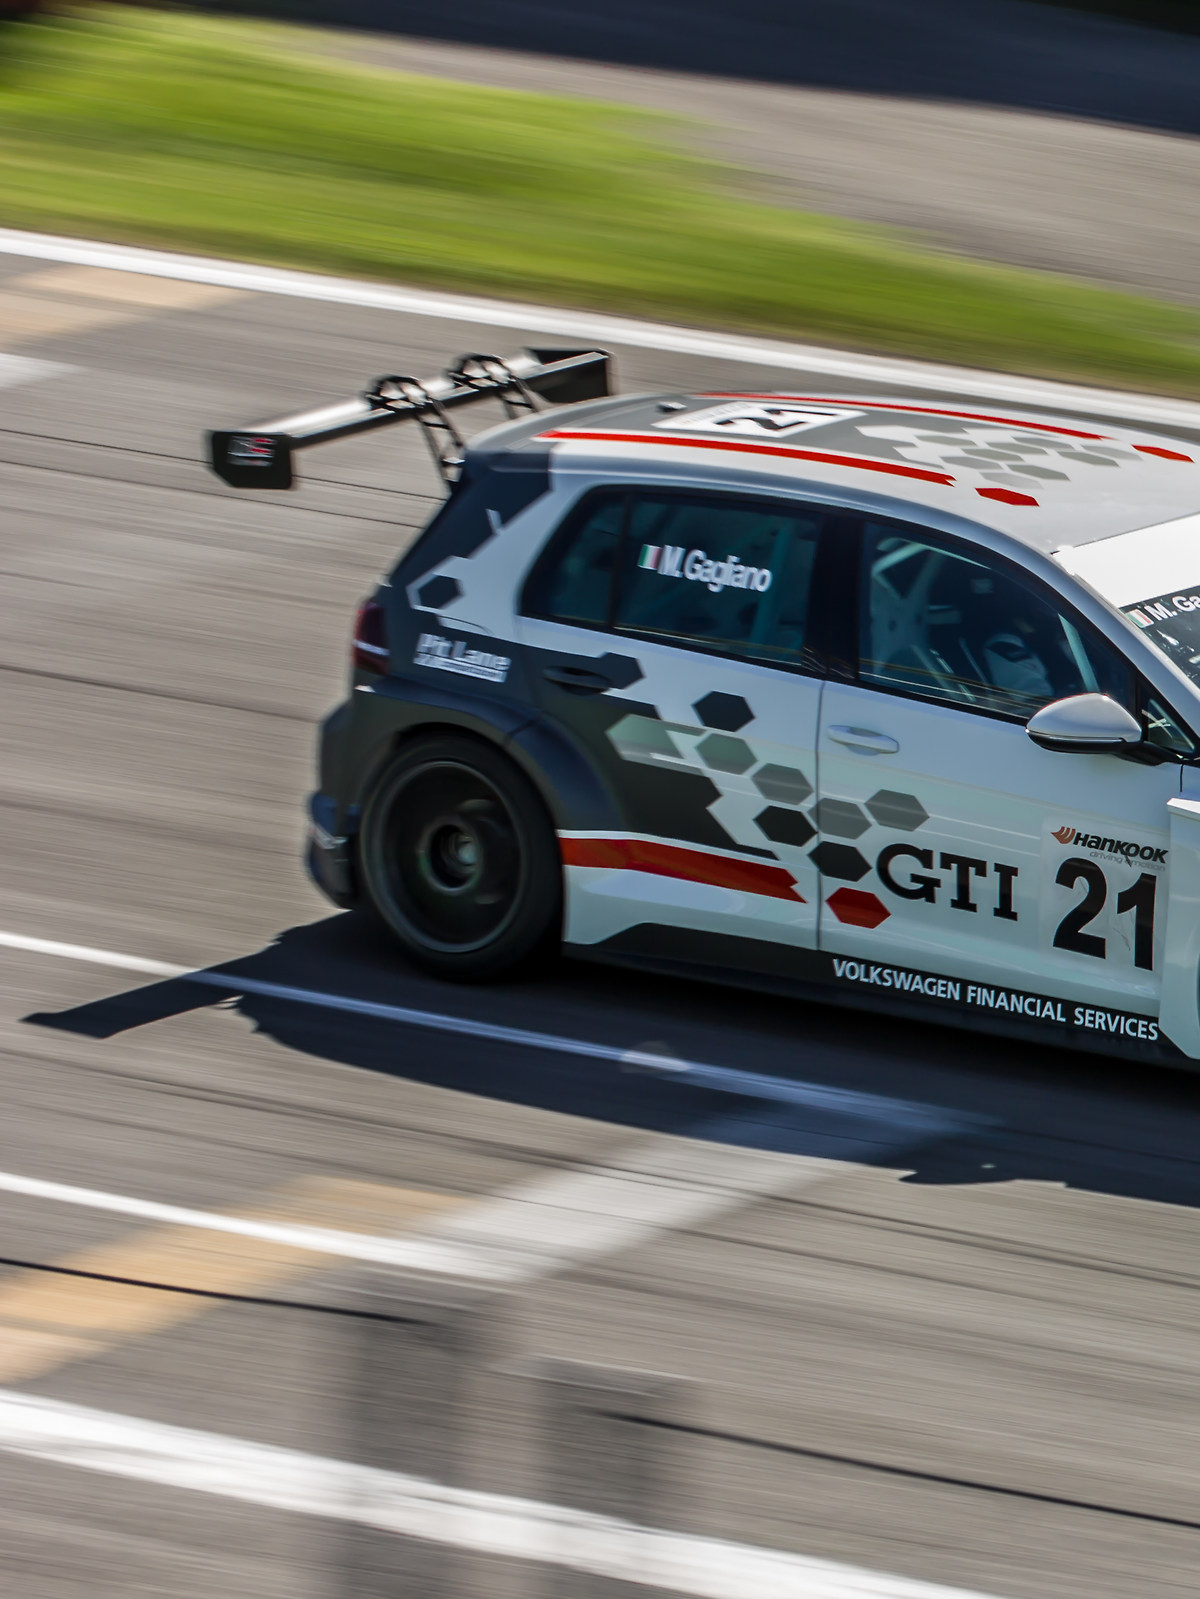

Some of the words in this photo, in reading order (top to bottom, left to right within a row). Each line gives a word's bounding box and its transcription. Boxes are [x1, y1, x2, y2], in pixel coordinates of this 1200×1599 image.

[713, 408, 838, 431] 21
[657, 544, 687, 578] M.
[684, 550, 773, 592] Gagliano
[1144, 602, 1178, 621] M.
[876, 842, 1019, 921] GTI
[1089, 850, 1123, 865] driving
[1052, 857, 1157, 971] 21
[832, 958, 961, 1001] VOLKSWAGEN
[966, 985, 1067, 1023] FINANCIAL
[1073, 1007, 1159, 1041] SERVICES
